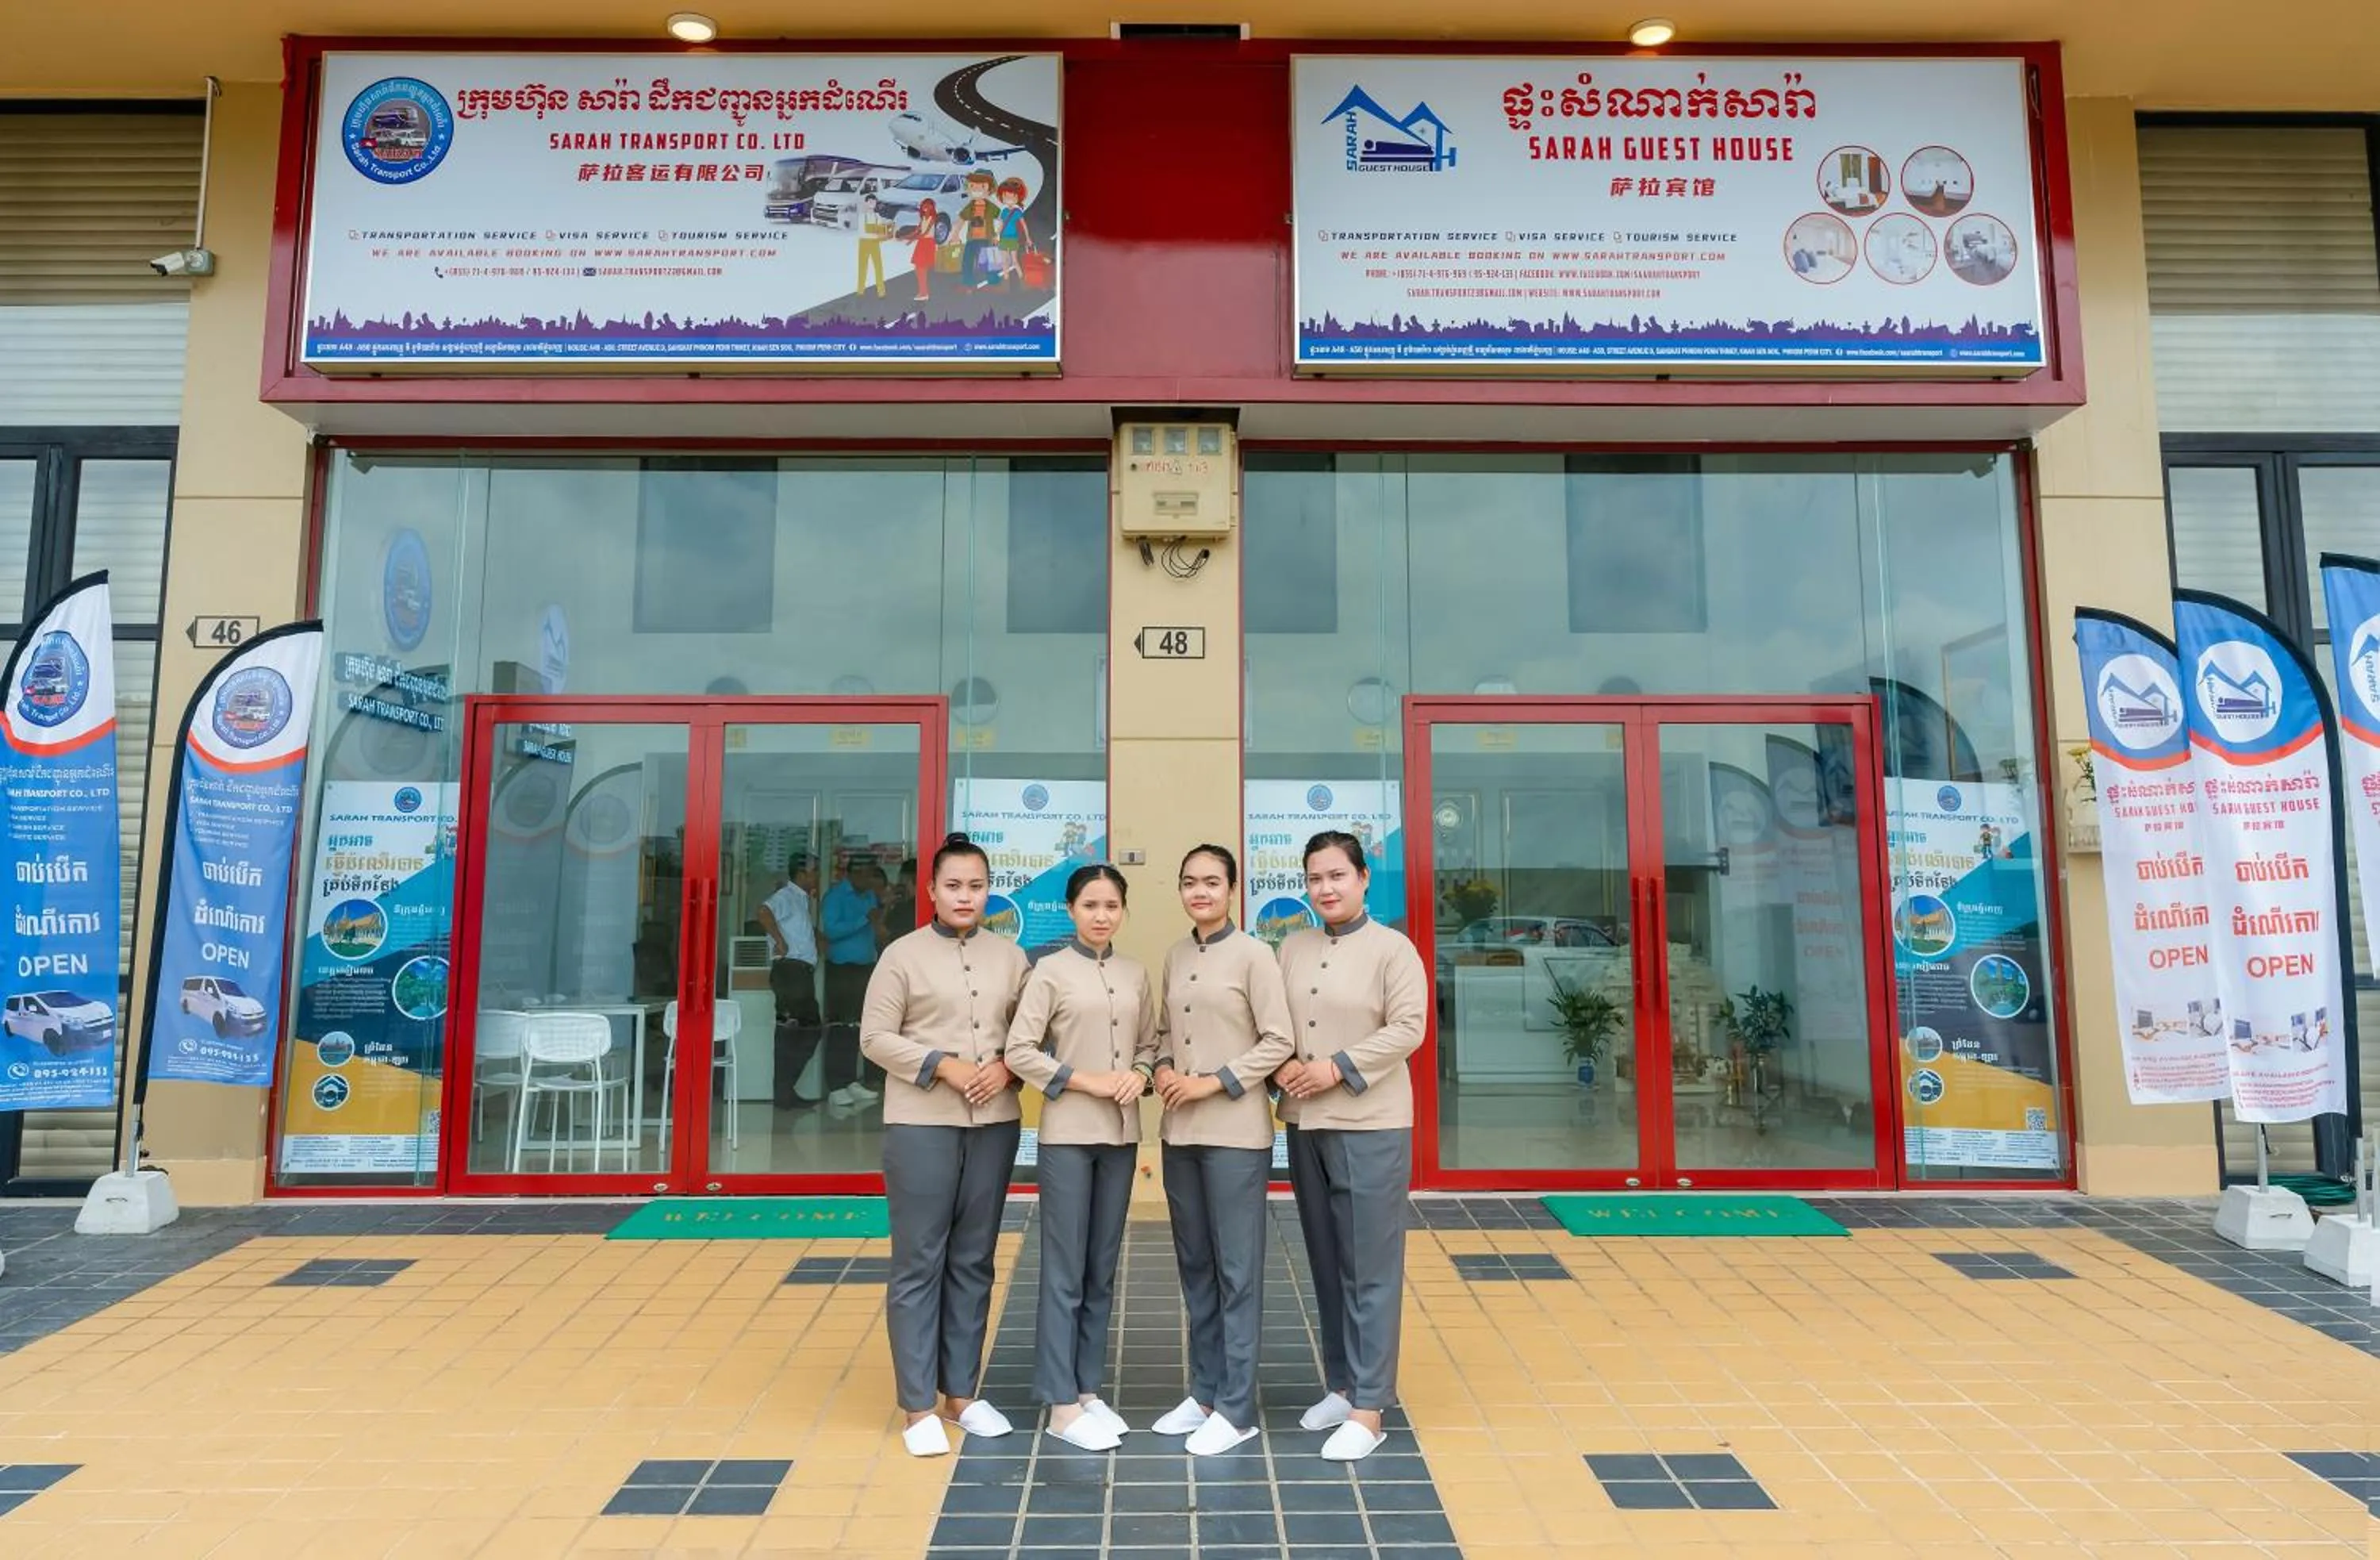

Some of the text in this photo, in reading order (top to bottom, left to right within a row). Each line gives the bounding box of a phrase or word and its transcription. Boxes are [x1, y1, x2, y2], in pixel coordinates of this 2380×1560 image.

[457, 83, 569, 120] ក្រុមហ៊ុន
[578, 78, 640, 110] សារ៉ា
[1503, 72, 1817, 130] ផ្ទះសំណាក់សារ៉ា
[550, 133, 805, 150] SARAH TRANSPORT CO. LTD
[1346, 111, 1357, 172] SARAH
[1529, 136, 1795, 161] SARAH GUEST HOUSE
[578, 163, 764, 182] 萨拉客运有限公司
[1610, 177, 1716, 198] 萨拉宾馆
[362, 230, 789, 240] TRANSPORTATION SERVICE VISA SERVICE TOURISM SERVICE
[1331, 232, 1441, 241] TRANSPORTATION
[1447, 232, 1499, 241] SERVICE
[1518, 232, 1547, 241] VISA
[1553, 233, 1606, 242] SERVICE
[1626, 233, 1680, 242] TOURISM
[370, 248, 389, 258] WE
[397, 248, 421, 258] ARE
[428, 248, 499, 258] AVAILABLE
[505, 248, 562, 258] BOOKING
[570, 249, 587, 258] ON
[1468, 252, 1522, 260] BOOKING
[1529, 252, 1545, 260] ON
[211, 620, 243, 644] 46
[1159, 631, 1188, 655] 48
[347, 694, 375, 713] SARAH
[1001, 812, 1063, 820] TRANSPORT
[2281, 798, 2321, 813] HOUSE
[1921, 813, 1977, 823] TRANSPORT
[18, 954, 88, 977] OPEN
[202, 942, 250, 970] OPEN
[2148, 944, 2209, 970] OPEN
[2246, 953, 2314, 978] OPEN
